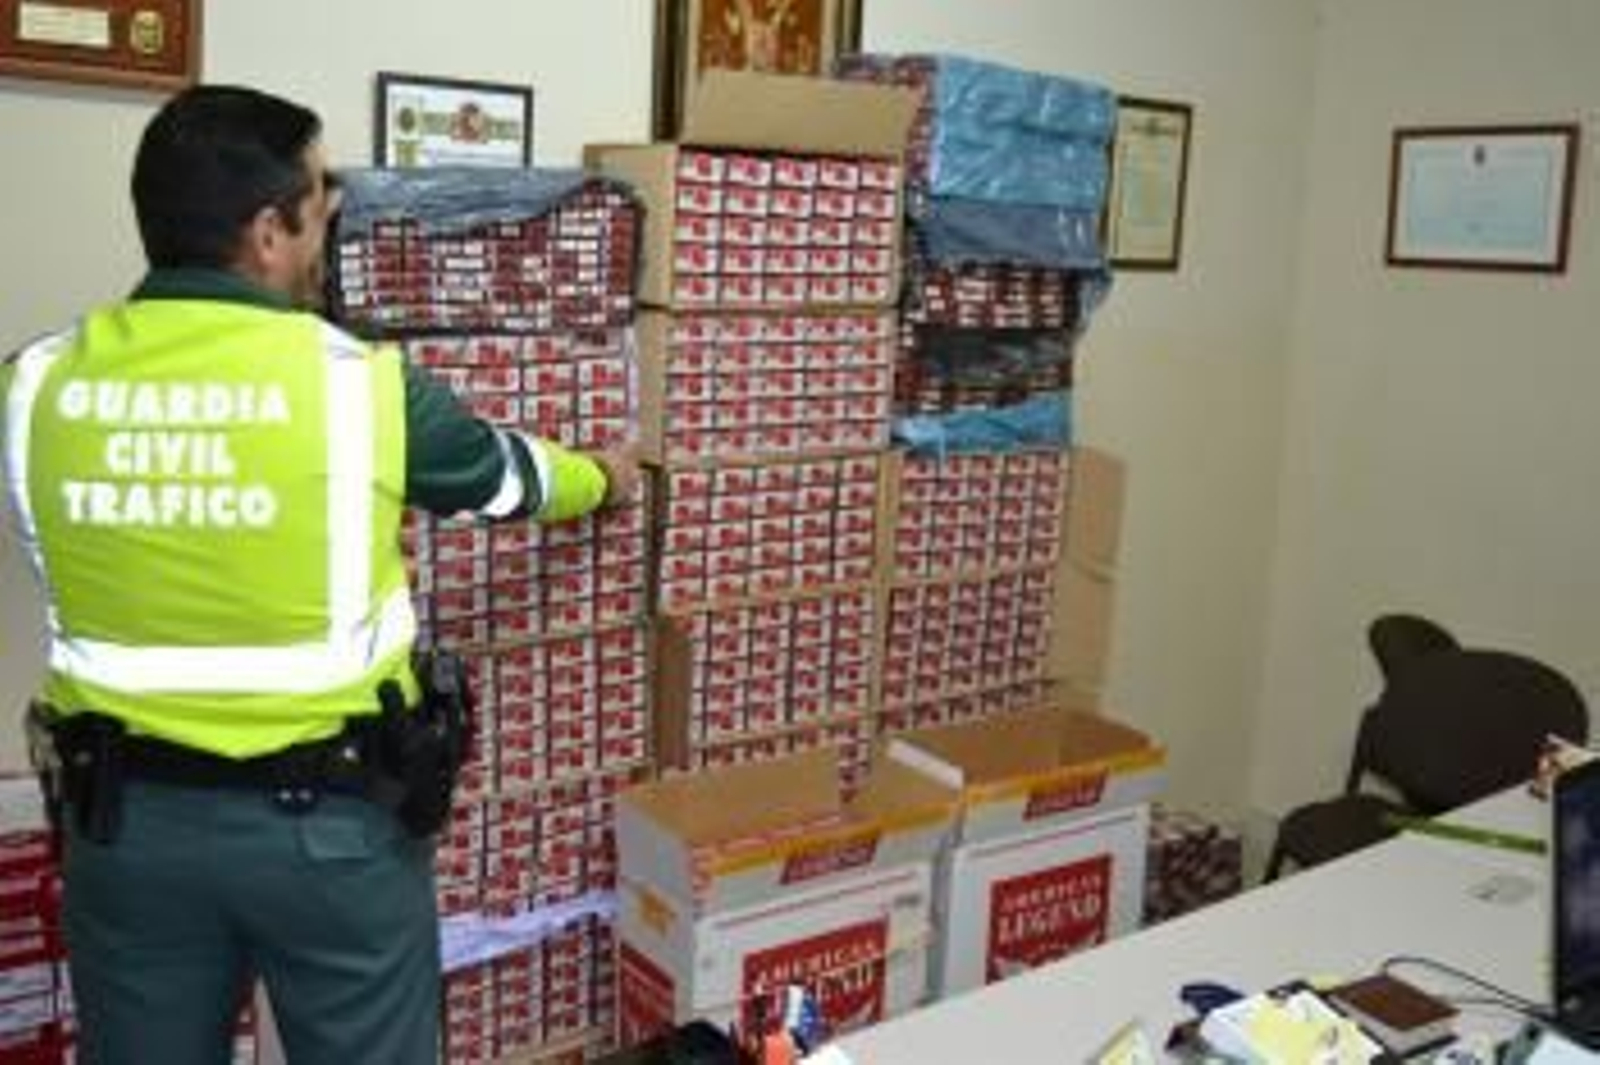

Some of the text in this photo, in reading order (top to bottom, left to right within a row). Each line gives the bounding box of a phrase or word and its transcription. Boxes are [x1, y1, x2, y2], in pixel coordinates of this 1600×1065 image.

[57, 380, 290, 424] GUARDIA
[106, 431, 235, 476] CIVIL
[62, 481, 278, 527] TRAFICO
[999, 894, 1100, 944] LEGEND
